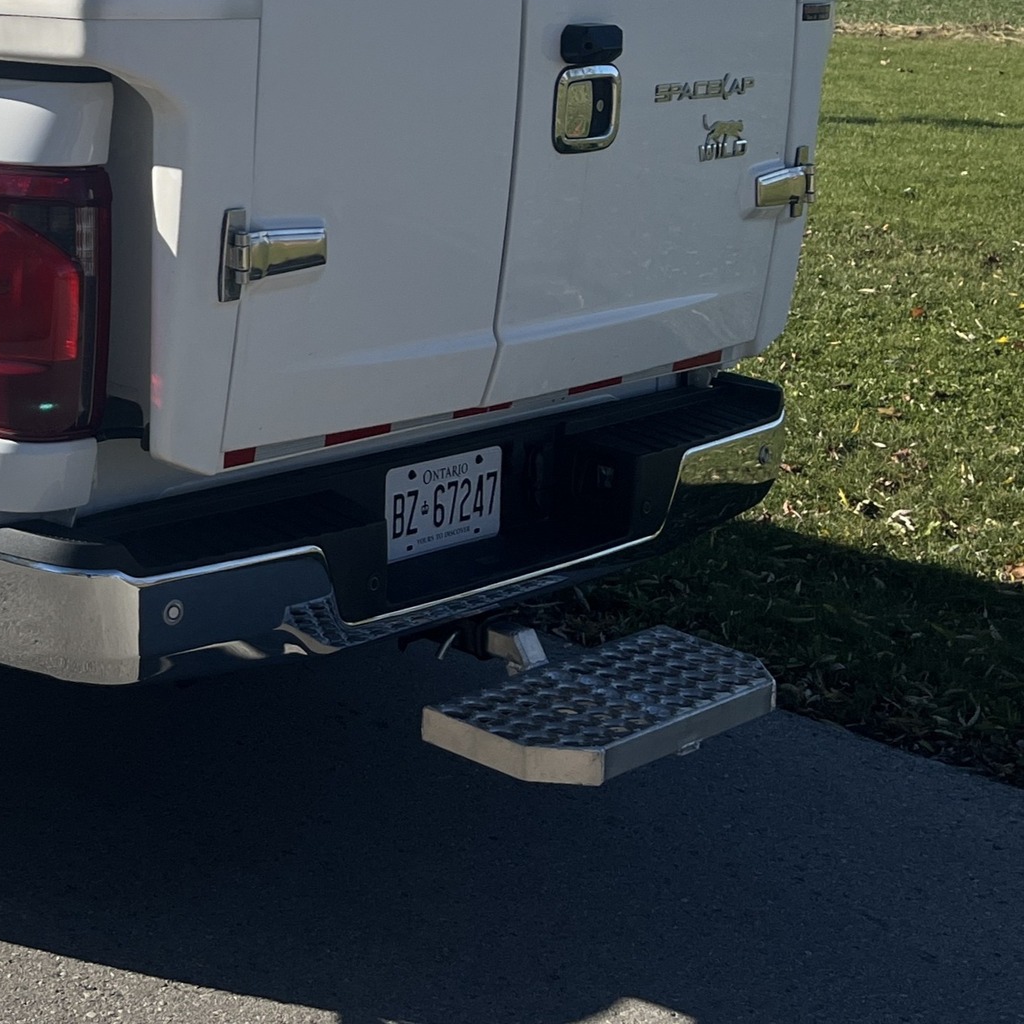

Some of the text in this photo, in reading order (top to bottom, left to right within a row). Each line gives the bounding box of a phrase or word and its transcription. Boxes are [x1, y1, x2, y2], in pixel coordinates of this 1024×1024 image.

[698, 140, 747, 163] WILD
[422, 462, 469, 485] ONTARIO
[433, 470, 498, 528] 67247
[436, 532, 444, 541] TO
